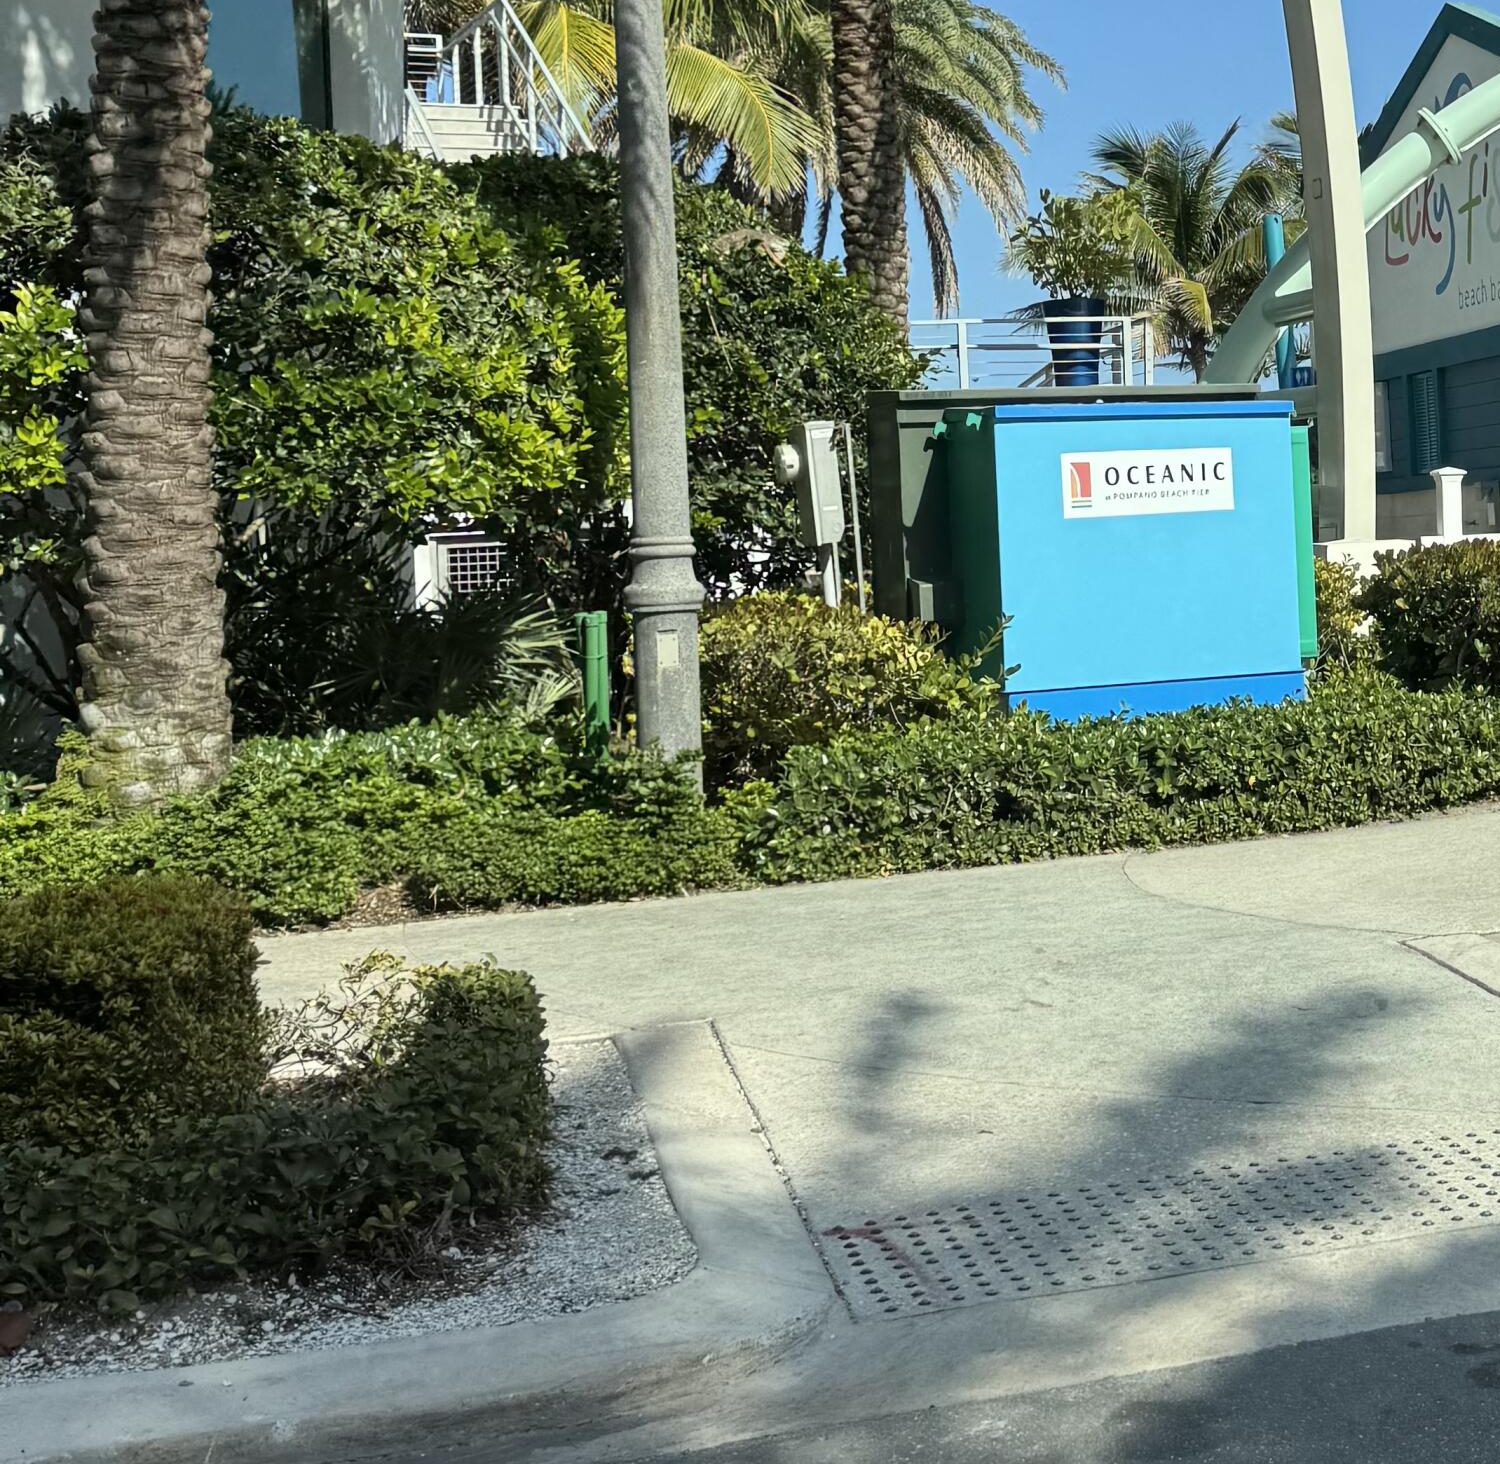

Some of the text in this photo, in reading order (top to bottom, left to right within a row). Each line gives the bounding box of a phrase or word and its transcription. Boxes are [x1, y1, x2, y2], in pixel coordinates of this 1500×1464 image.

[1458, 277, 1488, 309] beach
[1104, 461, 1225, 486] OCEANIC
[1113, 491, 1157, 500] POMPANO
[1160, 489, 1189, 498] BEACH
